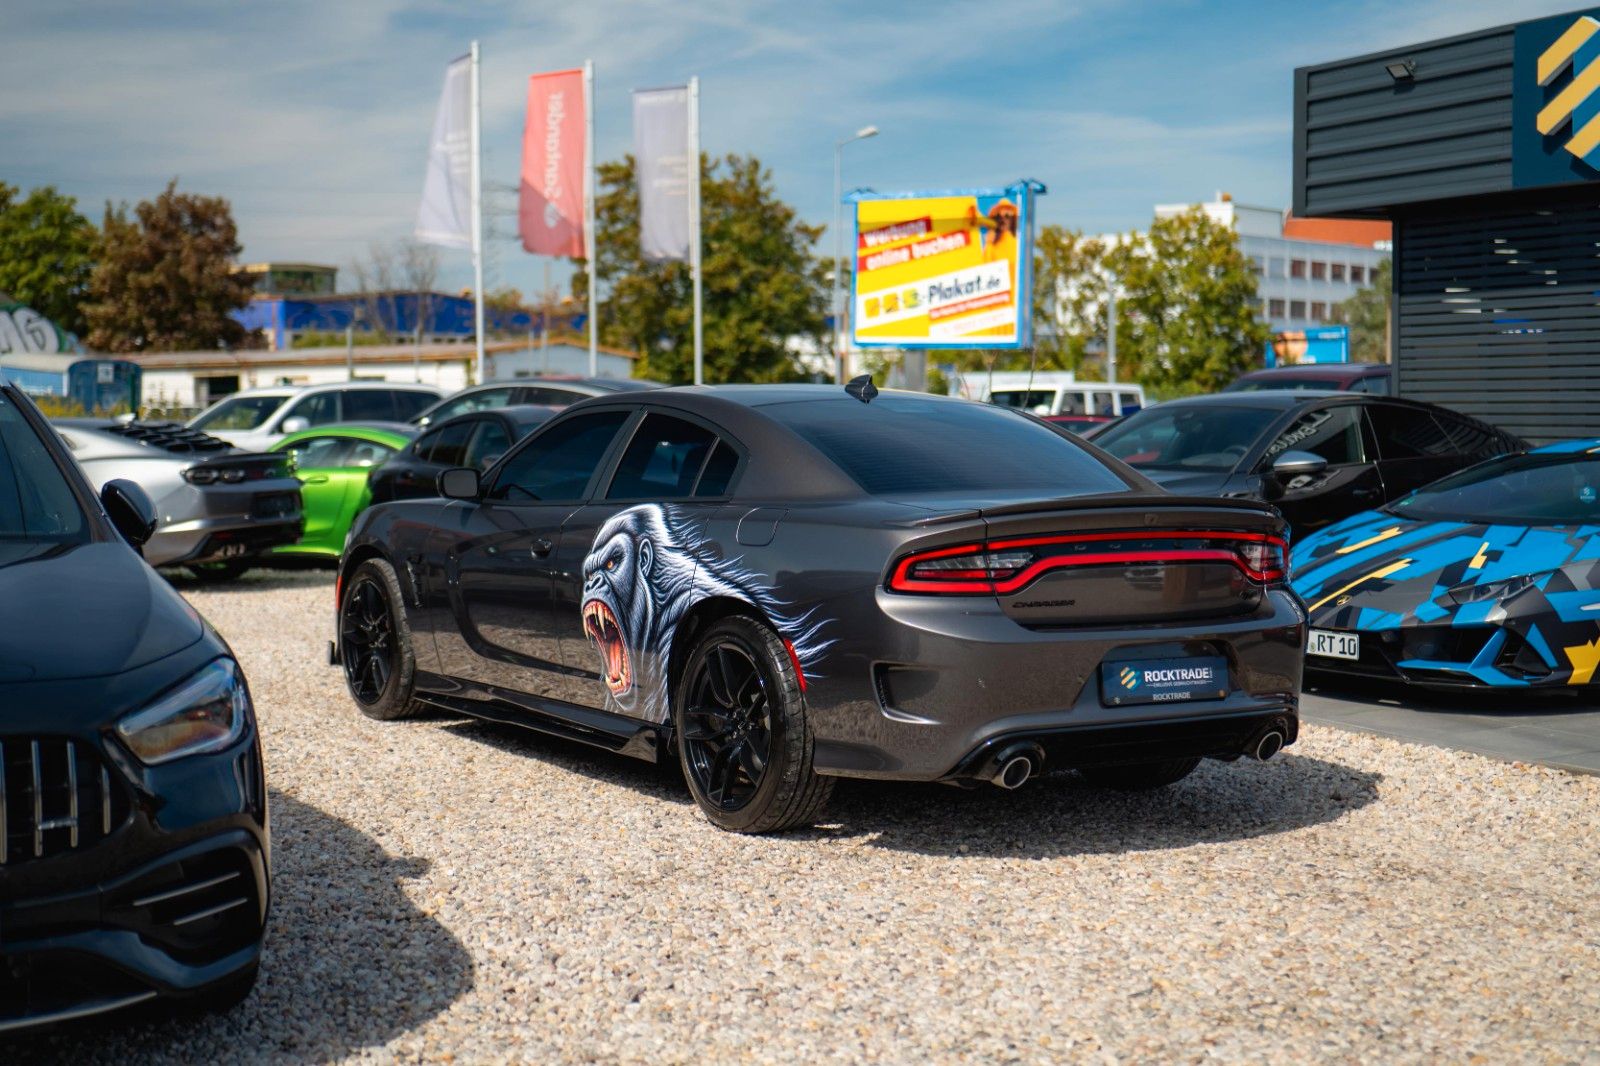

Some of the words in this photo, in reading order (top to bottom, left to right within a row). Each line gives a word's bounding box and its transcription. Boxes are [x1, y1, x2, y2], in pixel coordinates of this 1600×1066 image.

[1339, 637, 1356, 656] 10
[1144, 667, 1209, 683] ROCKTRADE
[1152, 691, 1191, 701] ROCKTRADE
